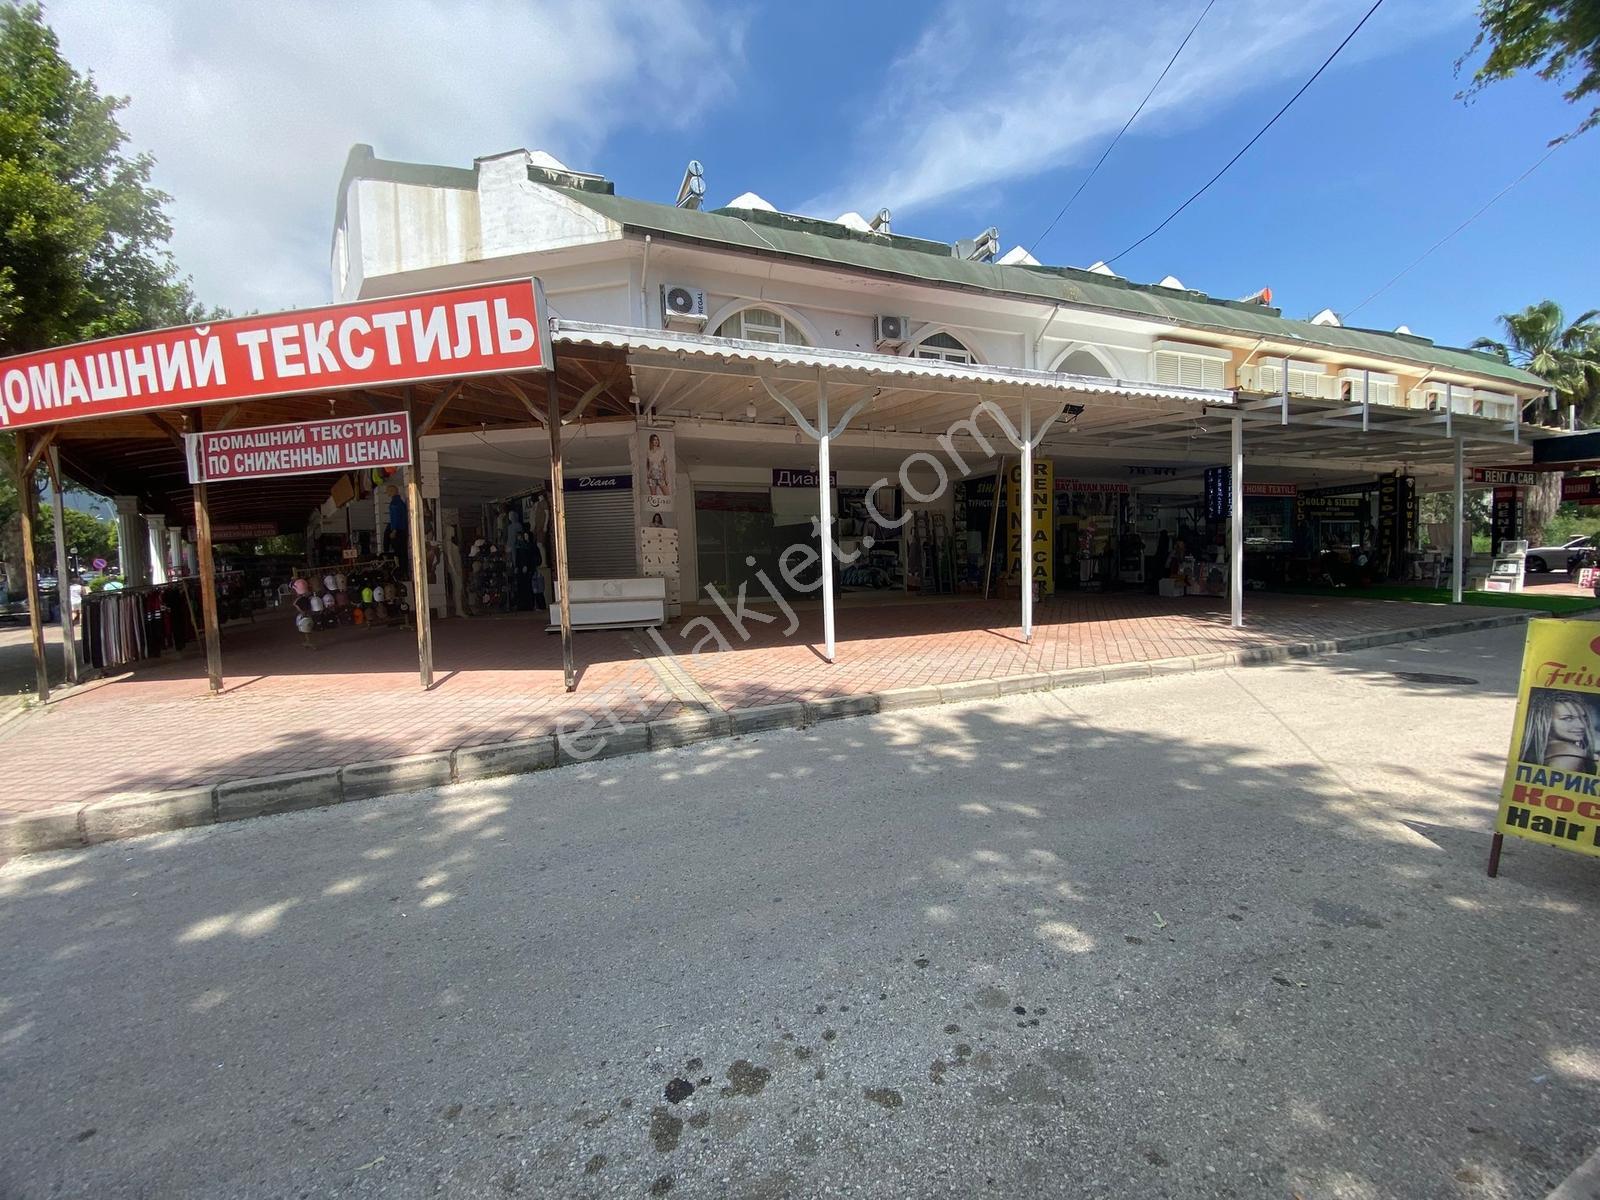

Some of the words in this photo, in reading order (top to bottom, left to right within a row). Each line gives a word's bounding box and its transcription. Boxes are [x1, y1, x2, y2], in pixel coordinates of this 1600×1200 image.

[237, 297, 536, 381] ТЕКСТИЛЬ
[207, 425, 306, 453] ДОМАШНИЙ
[310, 419, 402, 442] ТЕКСТИЛЬ
[208, 453, 230, 475] ПО
[234, 444, 340, 473] СНИЖЕННЫМ
[345, 438, 405, 464] ЦЕНАМ
[579, 476, 617, 487] Diana
[1033, 463, 1049, 520] RENT
[1246, 485, 1267, 493] HOME
[1268, 486, 1296, 494] TEXTILE
[1485, 470, 1509, 483] RENT
[1509, 473, 1516, 483] A
[1517, 473, 1535, 485] CAR
[1305, 498, 1326, 506] GOLD
[1033, 530, 1049, 543] A
[1033, 551, 1049, 594] CAR
[1516, 765, 1600, 797] ПАРИК
[1506, 806, 1585, 841] Hair
